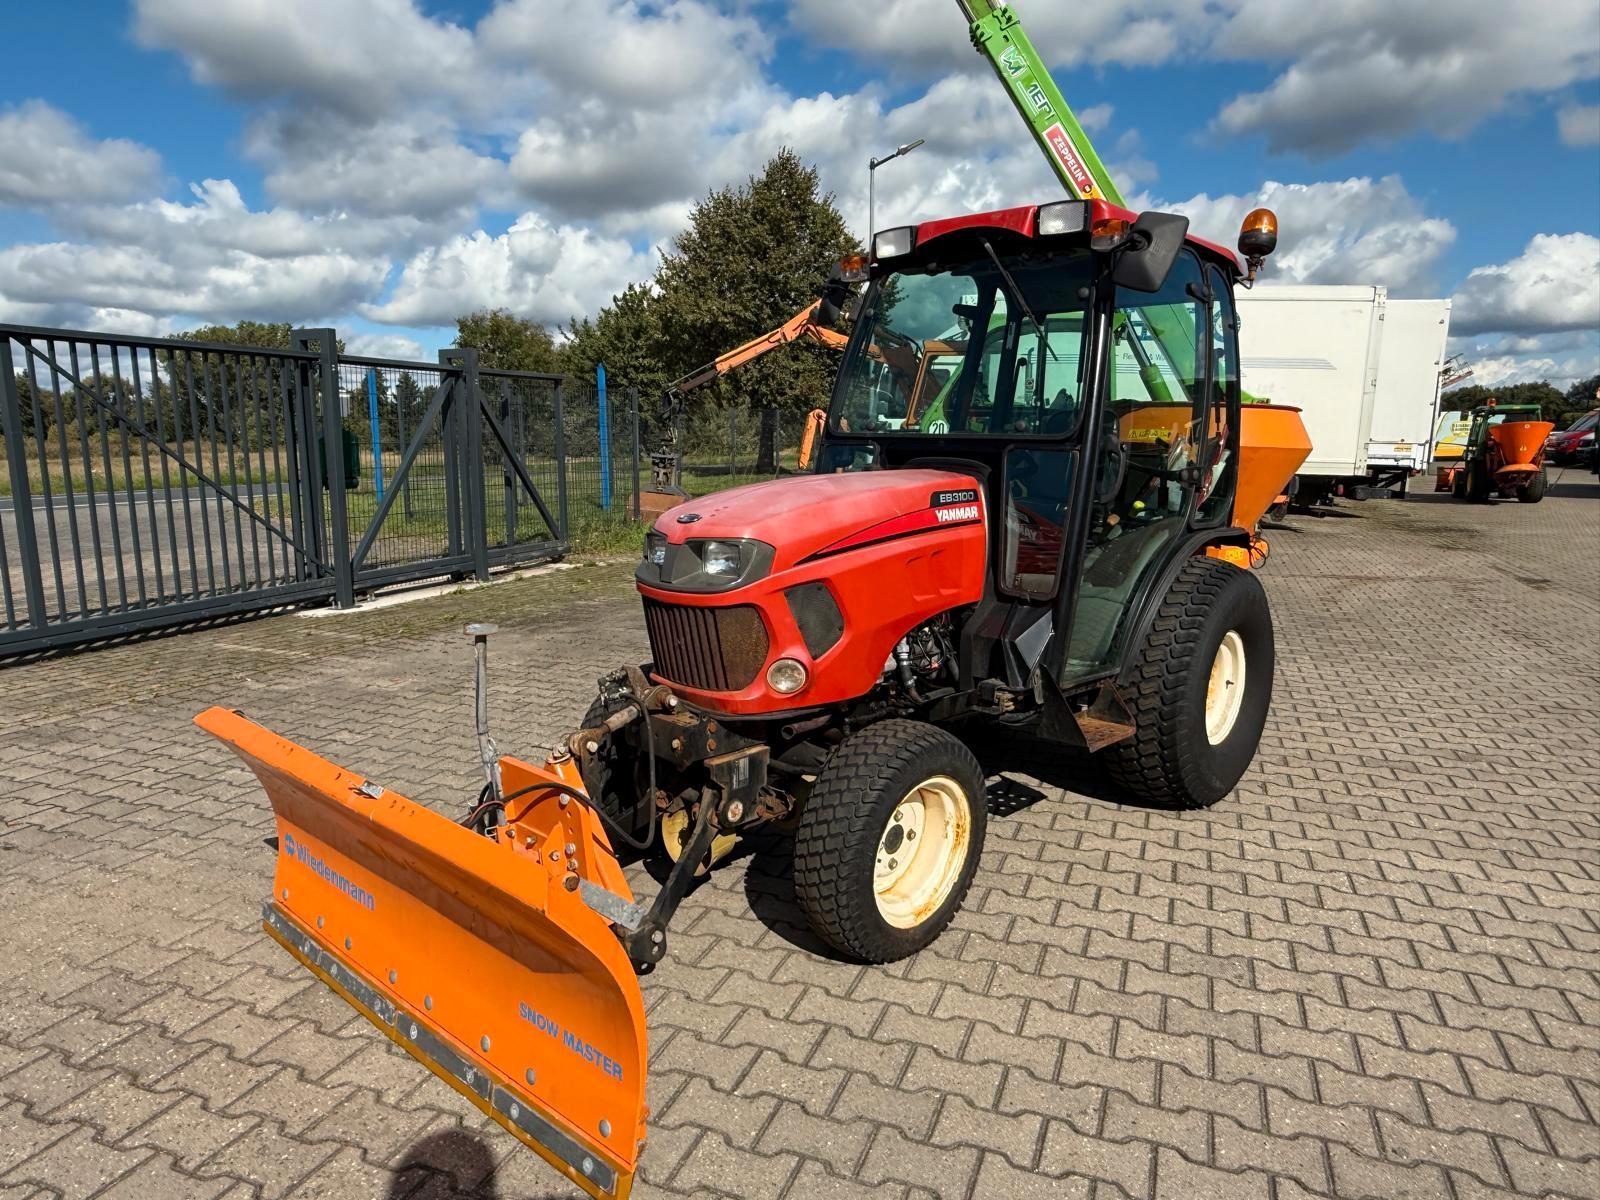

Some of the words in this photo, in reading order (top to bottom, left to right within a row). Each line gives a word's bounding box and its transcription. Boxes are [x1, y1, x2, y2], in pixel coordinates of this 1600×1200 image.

[1053, 136, 1086, 182] ZEPPELIN
[935, 506, 978, 522] YANMAR
[940, 491, 974, 503] EB3100
[296, 841, 375, 912] Wiedenmann
[519, 1001, 558, 1038] SNOW
[563, 1029, 623, 1081] MASTER
